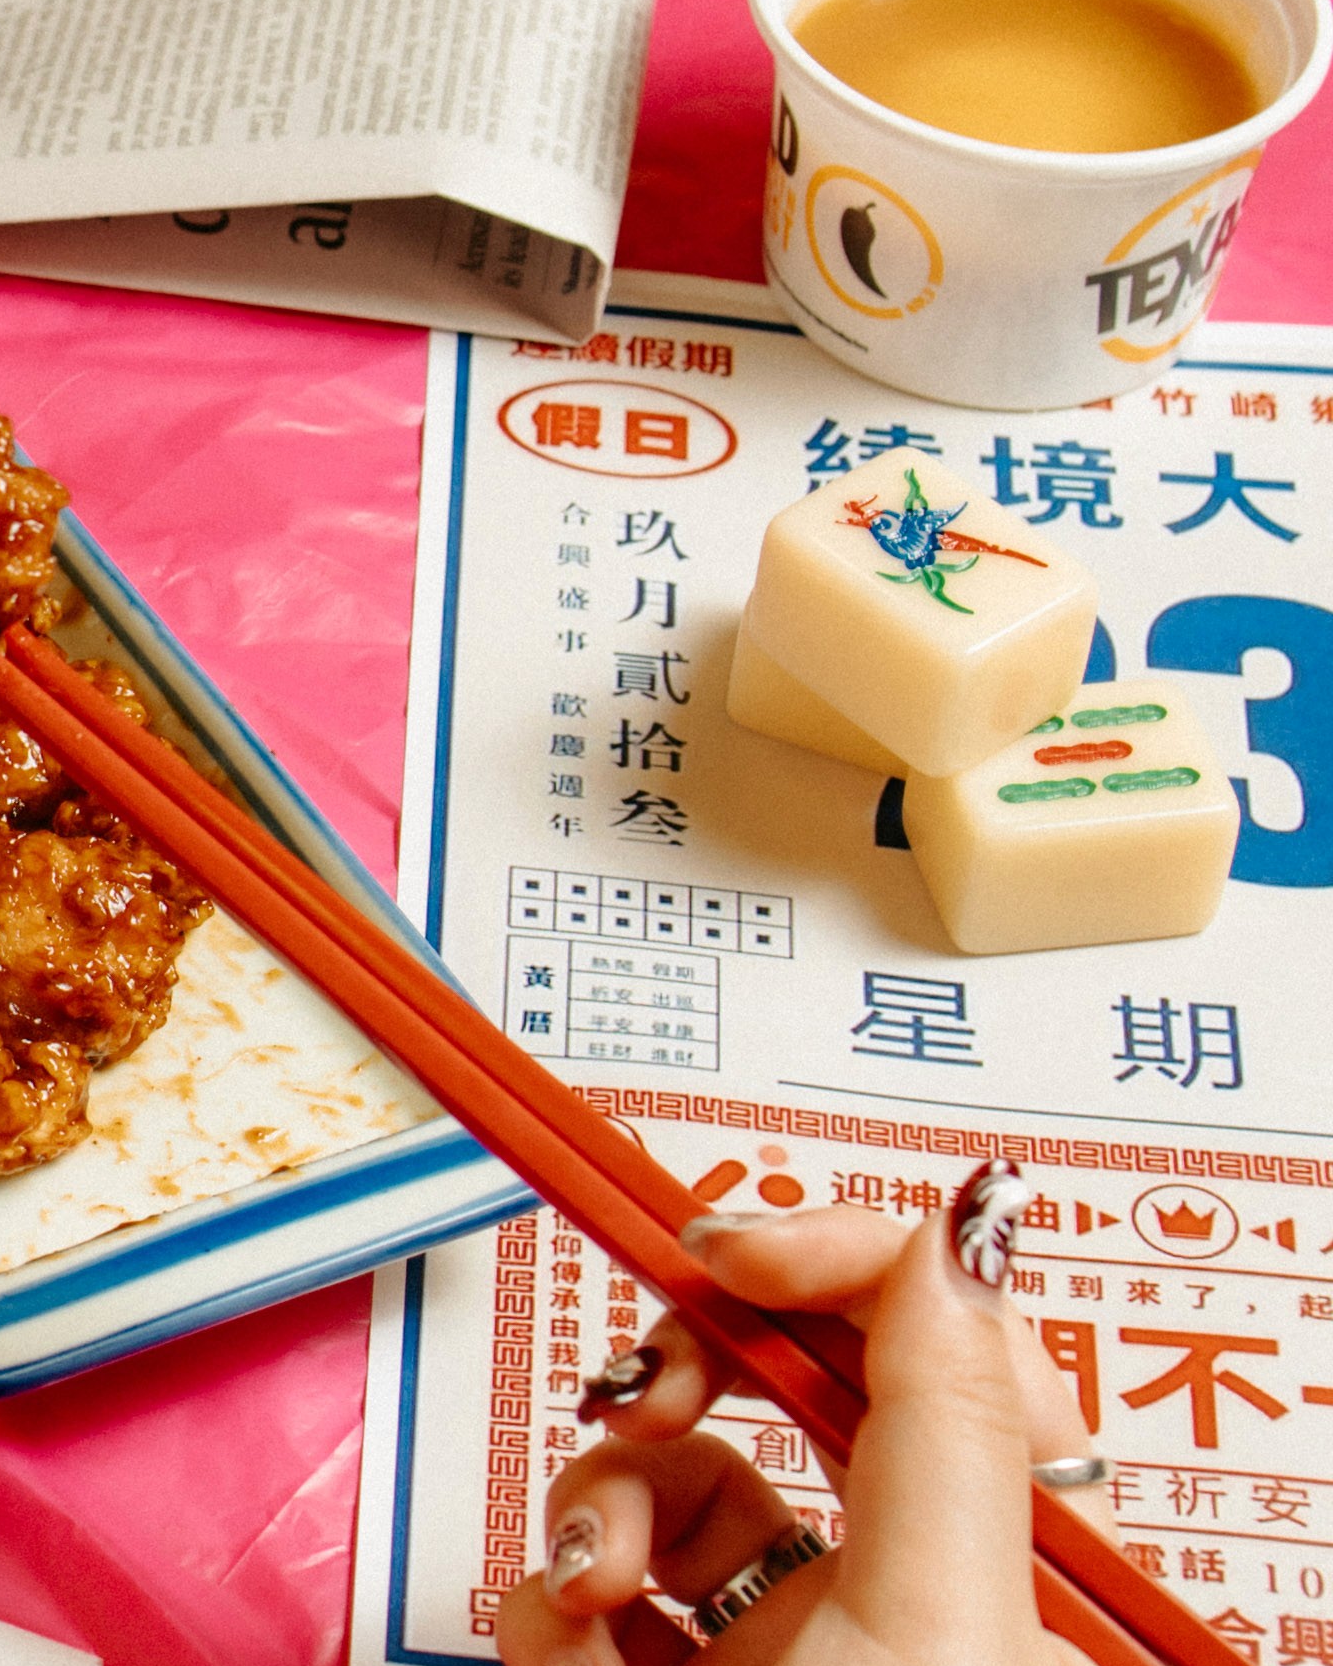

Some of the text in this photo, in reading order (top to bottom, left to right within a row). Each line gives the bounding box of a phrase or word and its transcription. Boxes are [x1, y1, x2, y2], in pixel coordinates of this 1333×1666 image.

[532, 402, 688, 460] 假日
[548, 692, 588, 837] 歡慶週年
[851, 970, 1245, 1091] 星期
[1123, 1541, 1226, 1583] 電話
